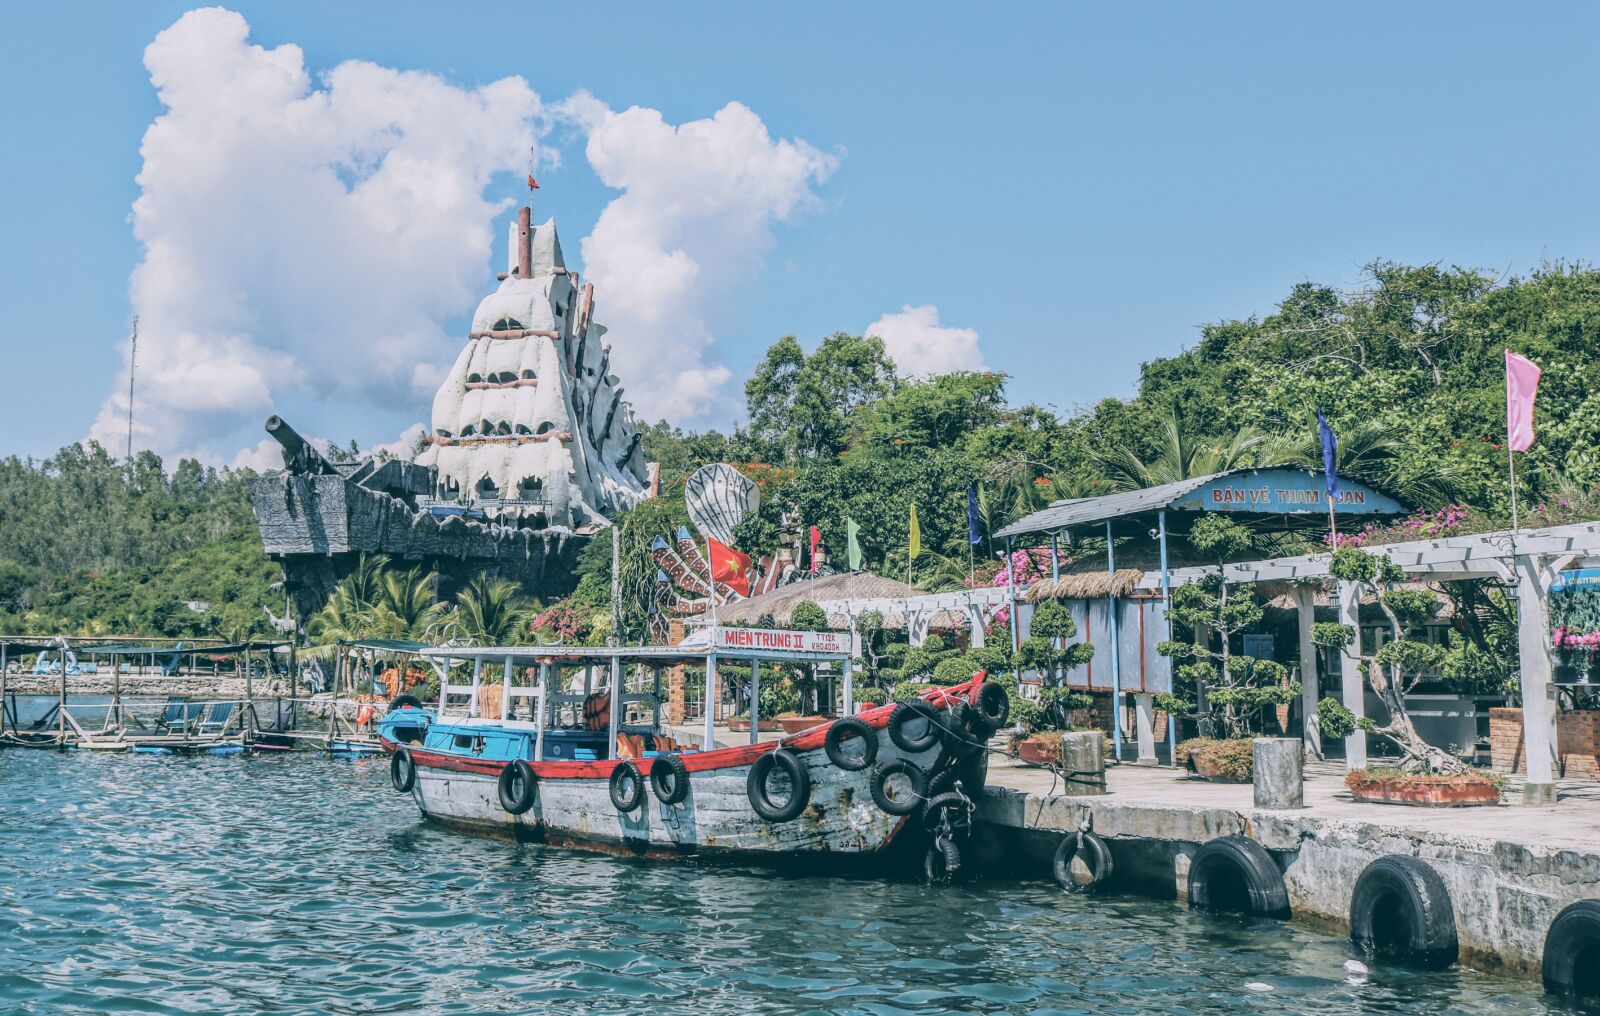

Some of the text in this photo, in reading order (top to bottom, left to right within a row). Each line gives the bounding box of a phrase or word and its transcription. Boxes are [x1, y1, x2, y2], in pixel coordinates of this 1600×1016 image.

[1212, 485, 1246, 503] BÁN
[1249, 486, 1271, 503] VÉ
[1275, 489, 1320, 504] THAM
[755, 631, 791, 648] TRUNG
[794, 635, 804, 649] II
